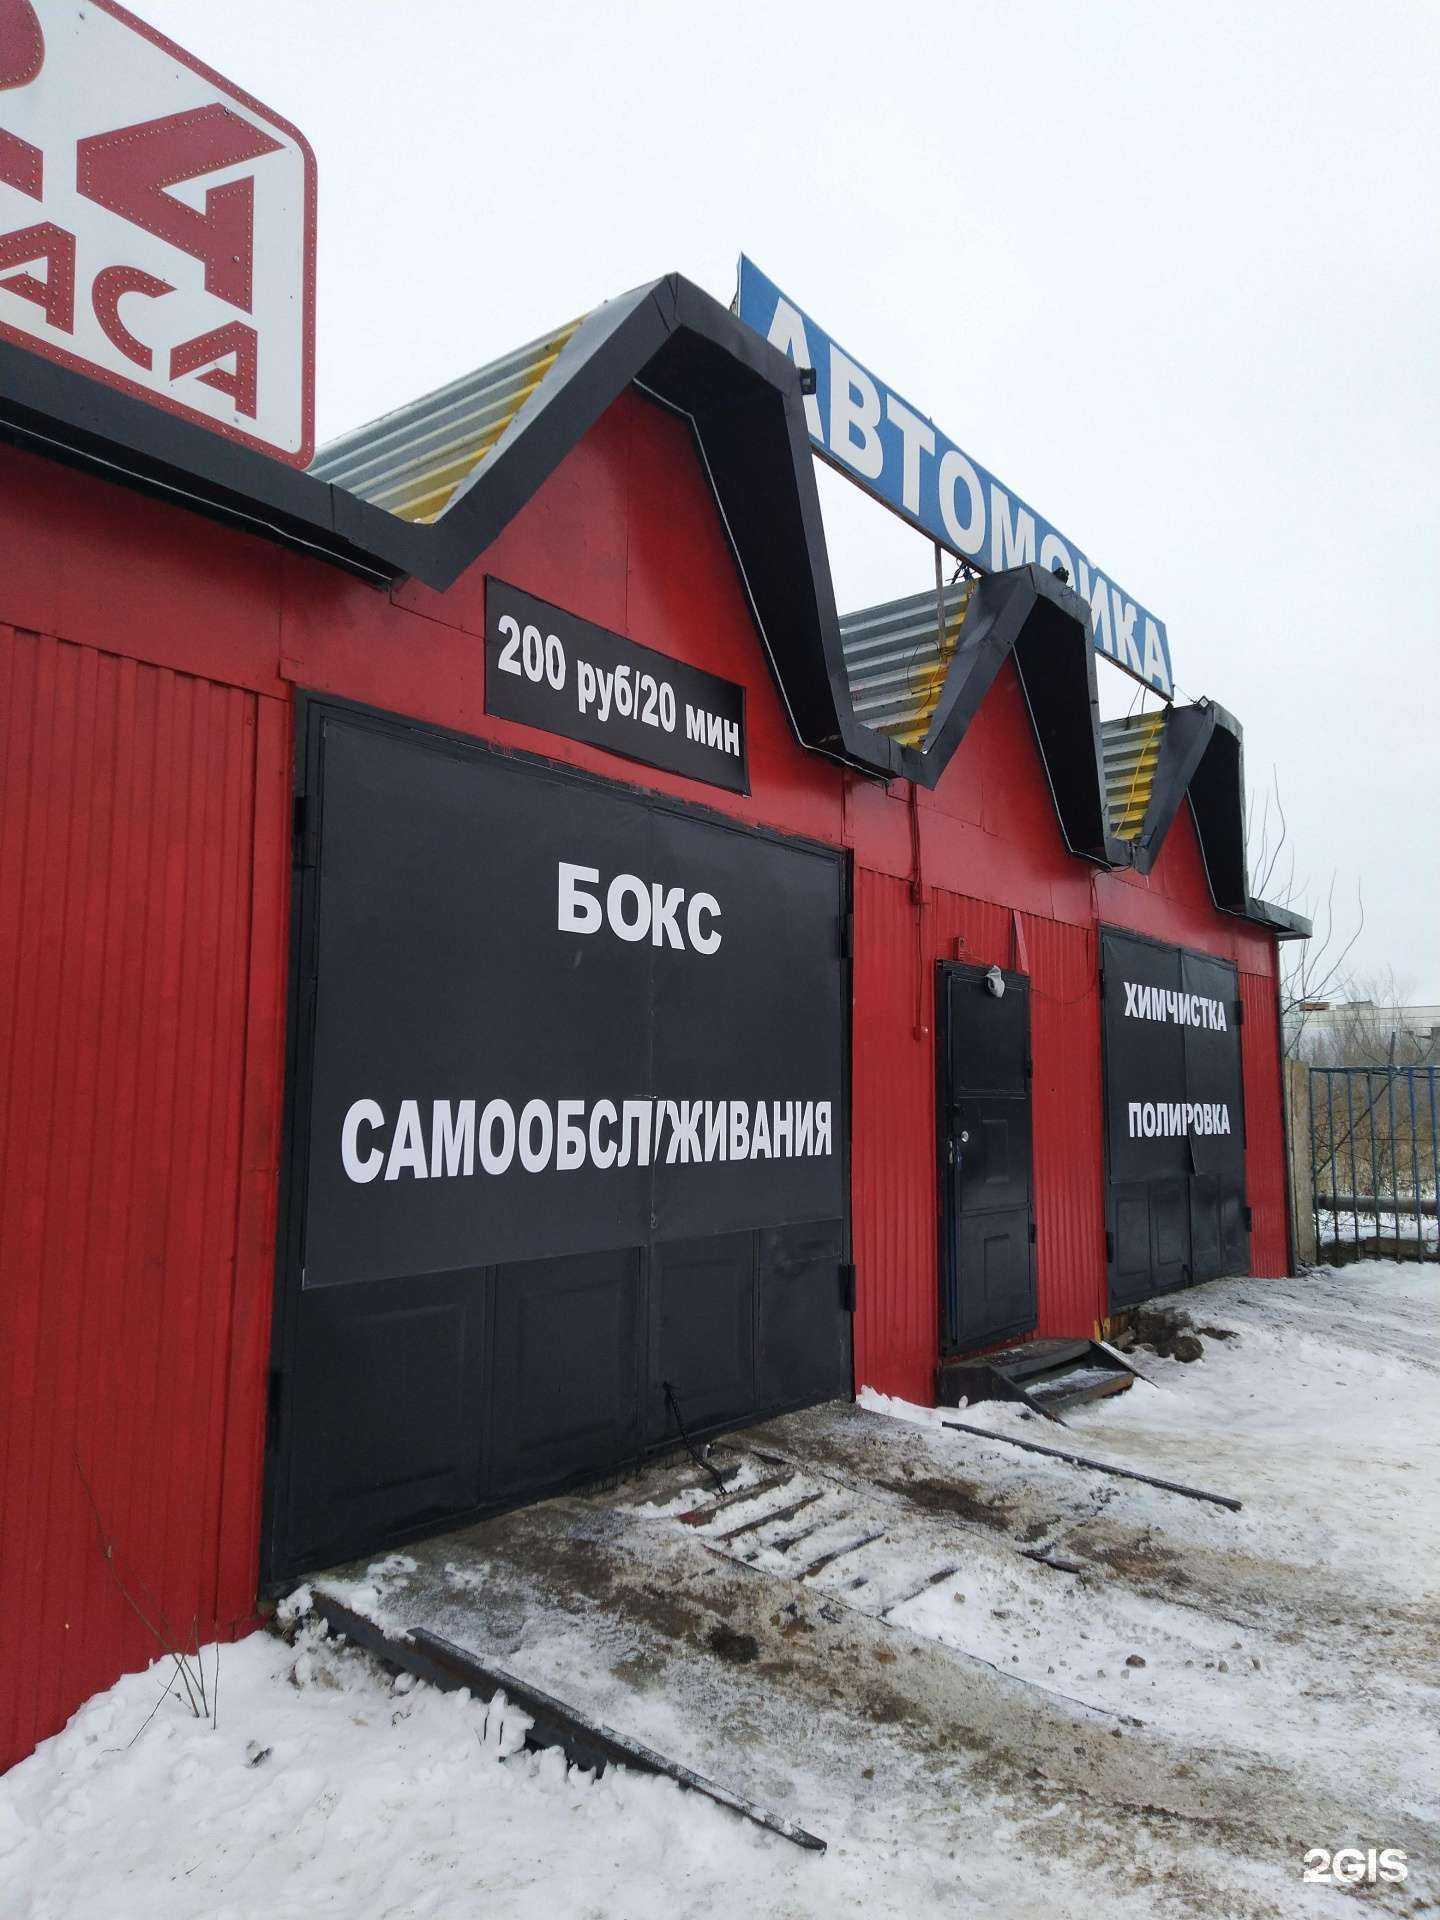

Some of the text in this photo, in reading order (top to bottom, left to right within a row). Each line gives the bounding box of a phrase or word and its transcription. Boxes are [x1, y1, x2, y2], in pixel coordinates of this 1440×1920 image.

[497, 614, 740, 757] 200 руб/20 мин
[557, 861, 722, 955] БОКС
[1123, 981, 1227, 1032] ХИМЧИСТКА
[1128, 1102, 1231, 1138] ПОЛИРОВКА
